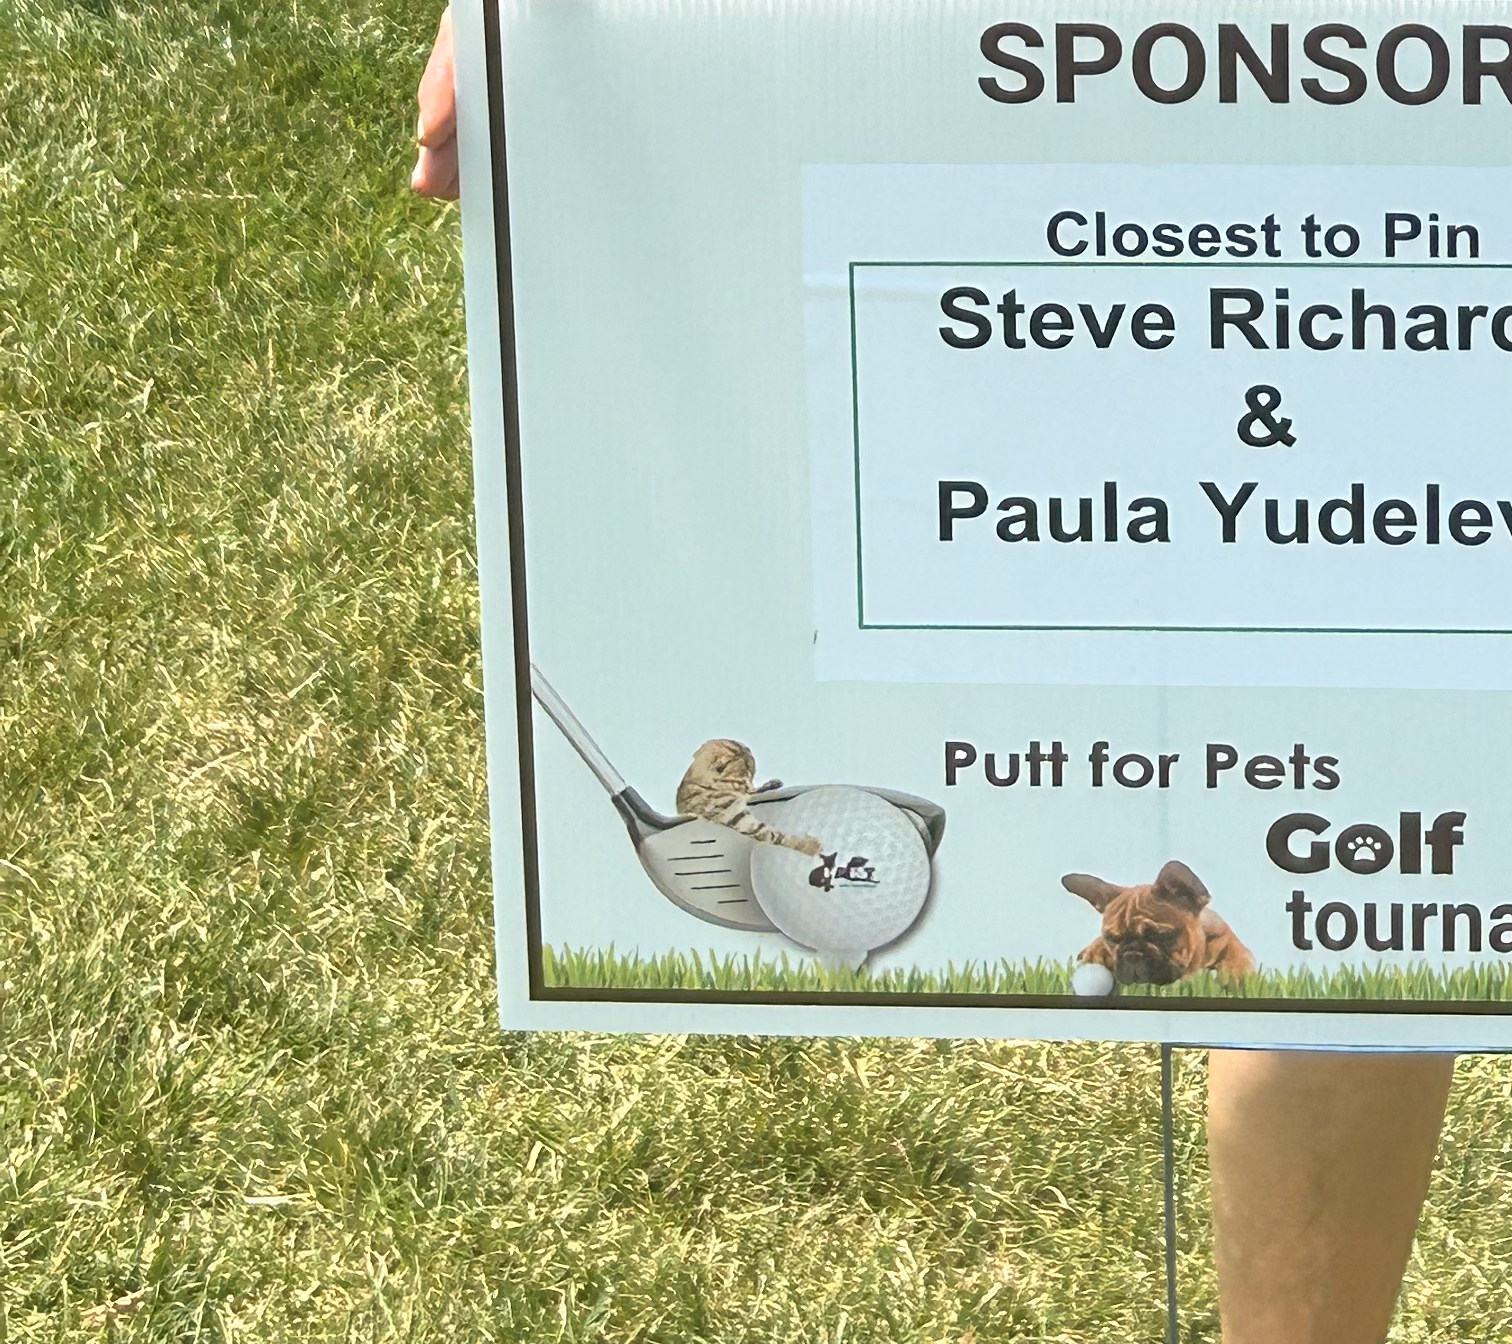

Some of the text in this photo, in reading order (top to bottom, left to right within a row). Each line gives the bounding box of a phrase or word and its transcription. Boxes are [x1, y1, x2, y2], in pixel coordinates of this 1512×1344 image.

[1046, 210, 1480, 259] Closest to Pin
[938, 286, 1176, 350] Steve
[1237, 384, 1297, 448] &
[938, 480, 1171, 544] Paula
[944, 741, 1341, 791] Putt for Pets
[1265, 811, 1467, 875] Golf
